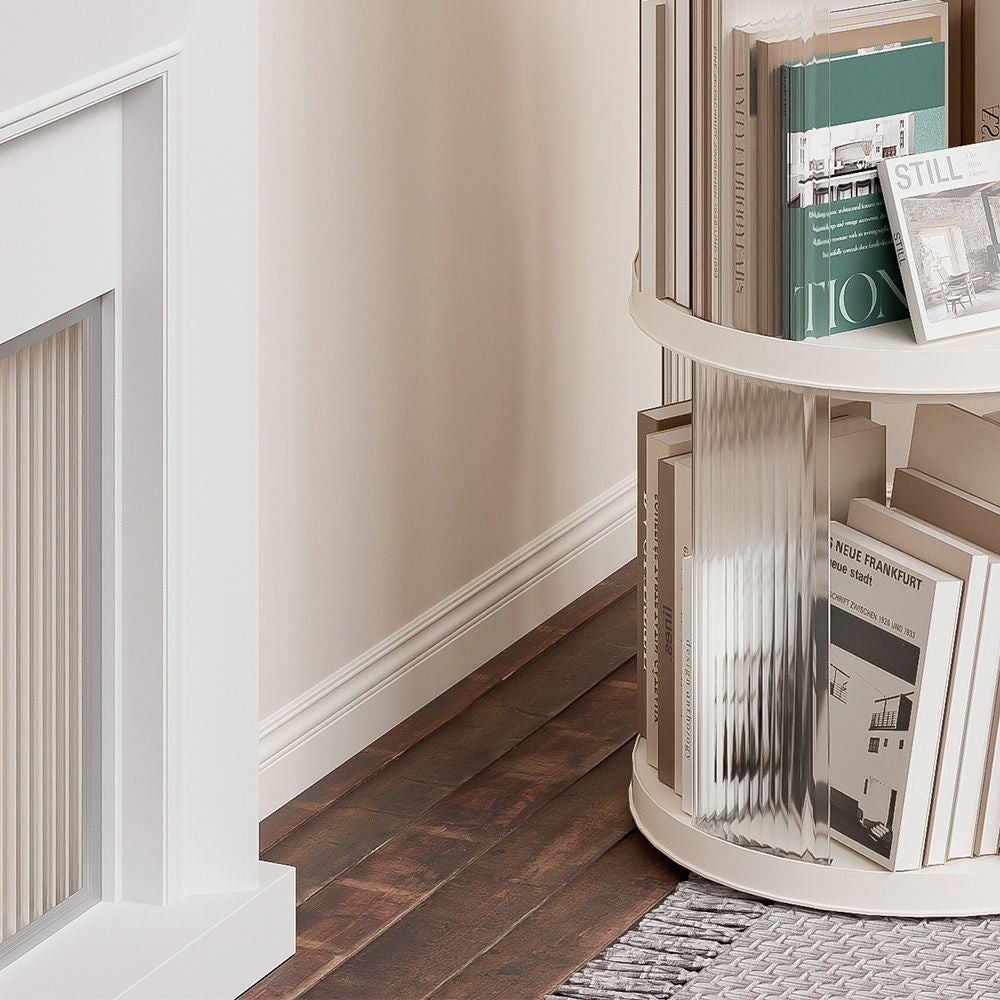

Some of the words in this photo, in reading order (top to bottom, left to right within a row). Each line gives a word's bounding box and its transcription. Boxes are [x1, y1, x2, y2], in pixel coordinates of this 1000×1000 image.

[894, 155, 963, 191] STILL
[893, 231, 906, 264] STILL
[835, 540, 862, 563] NEUE
[864, 554, 923, 591] FRANKFURT
[850, 568, 874, 587] stadt
[850, 600, 878, 621] ZWISCHEN
[891, 619, 904, 634] UND
